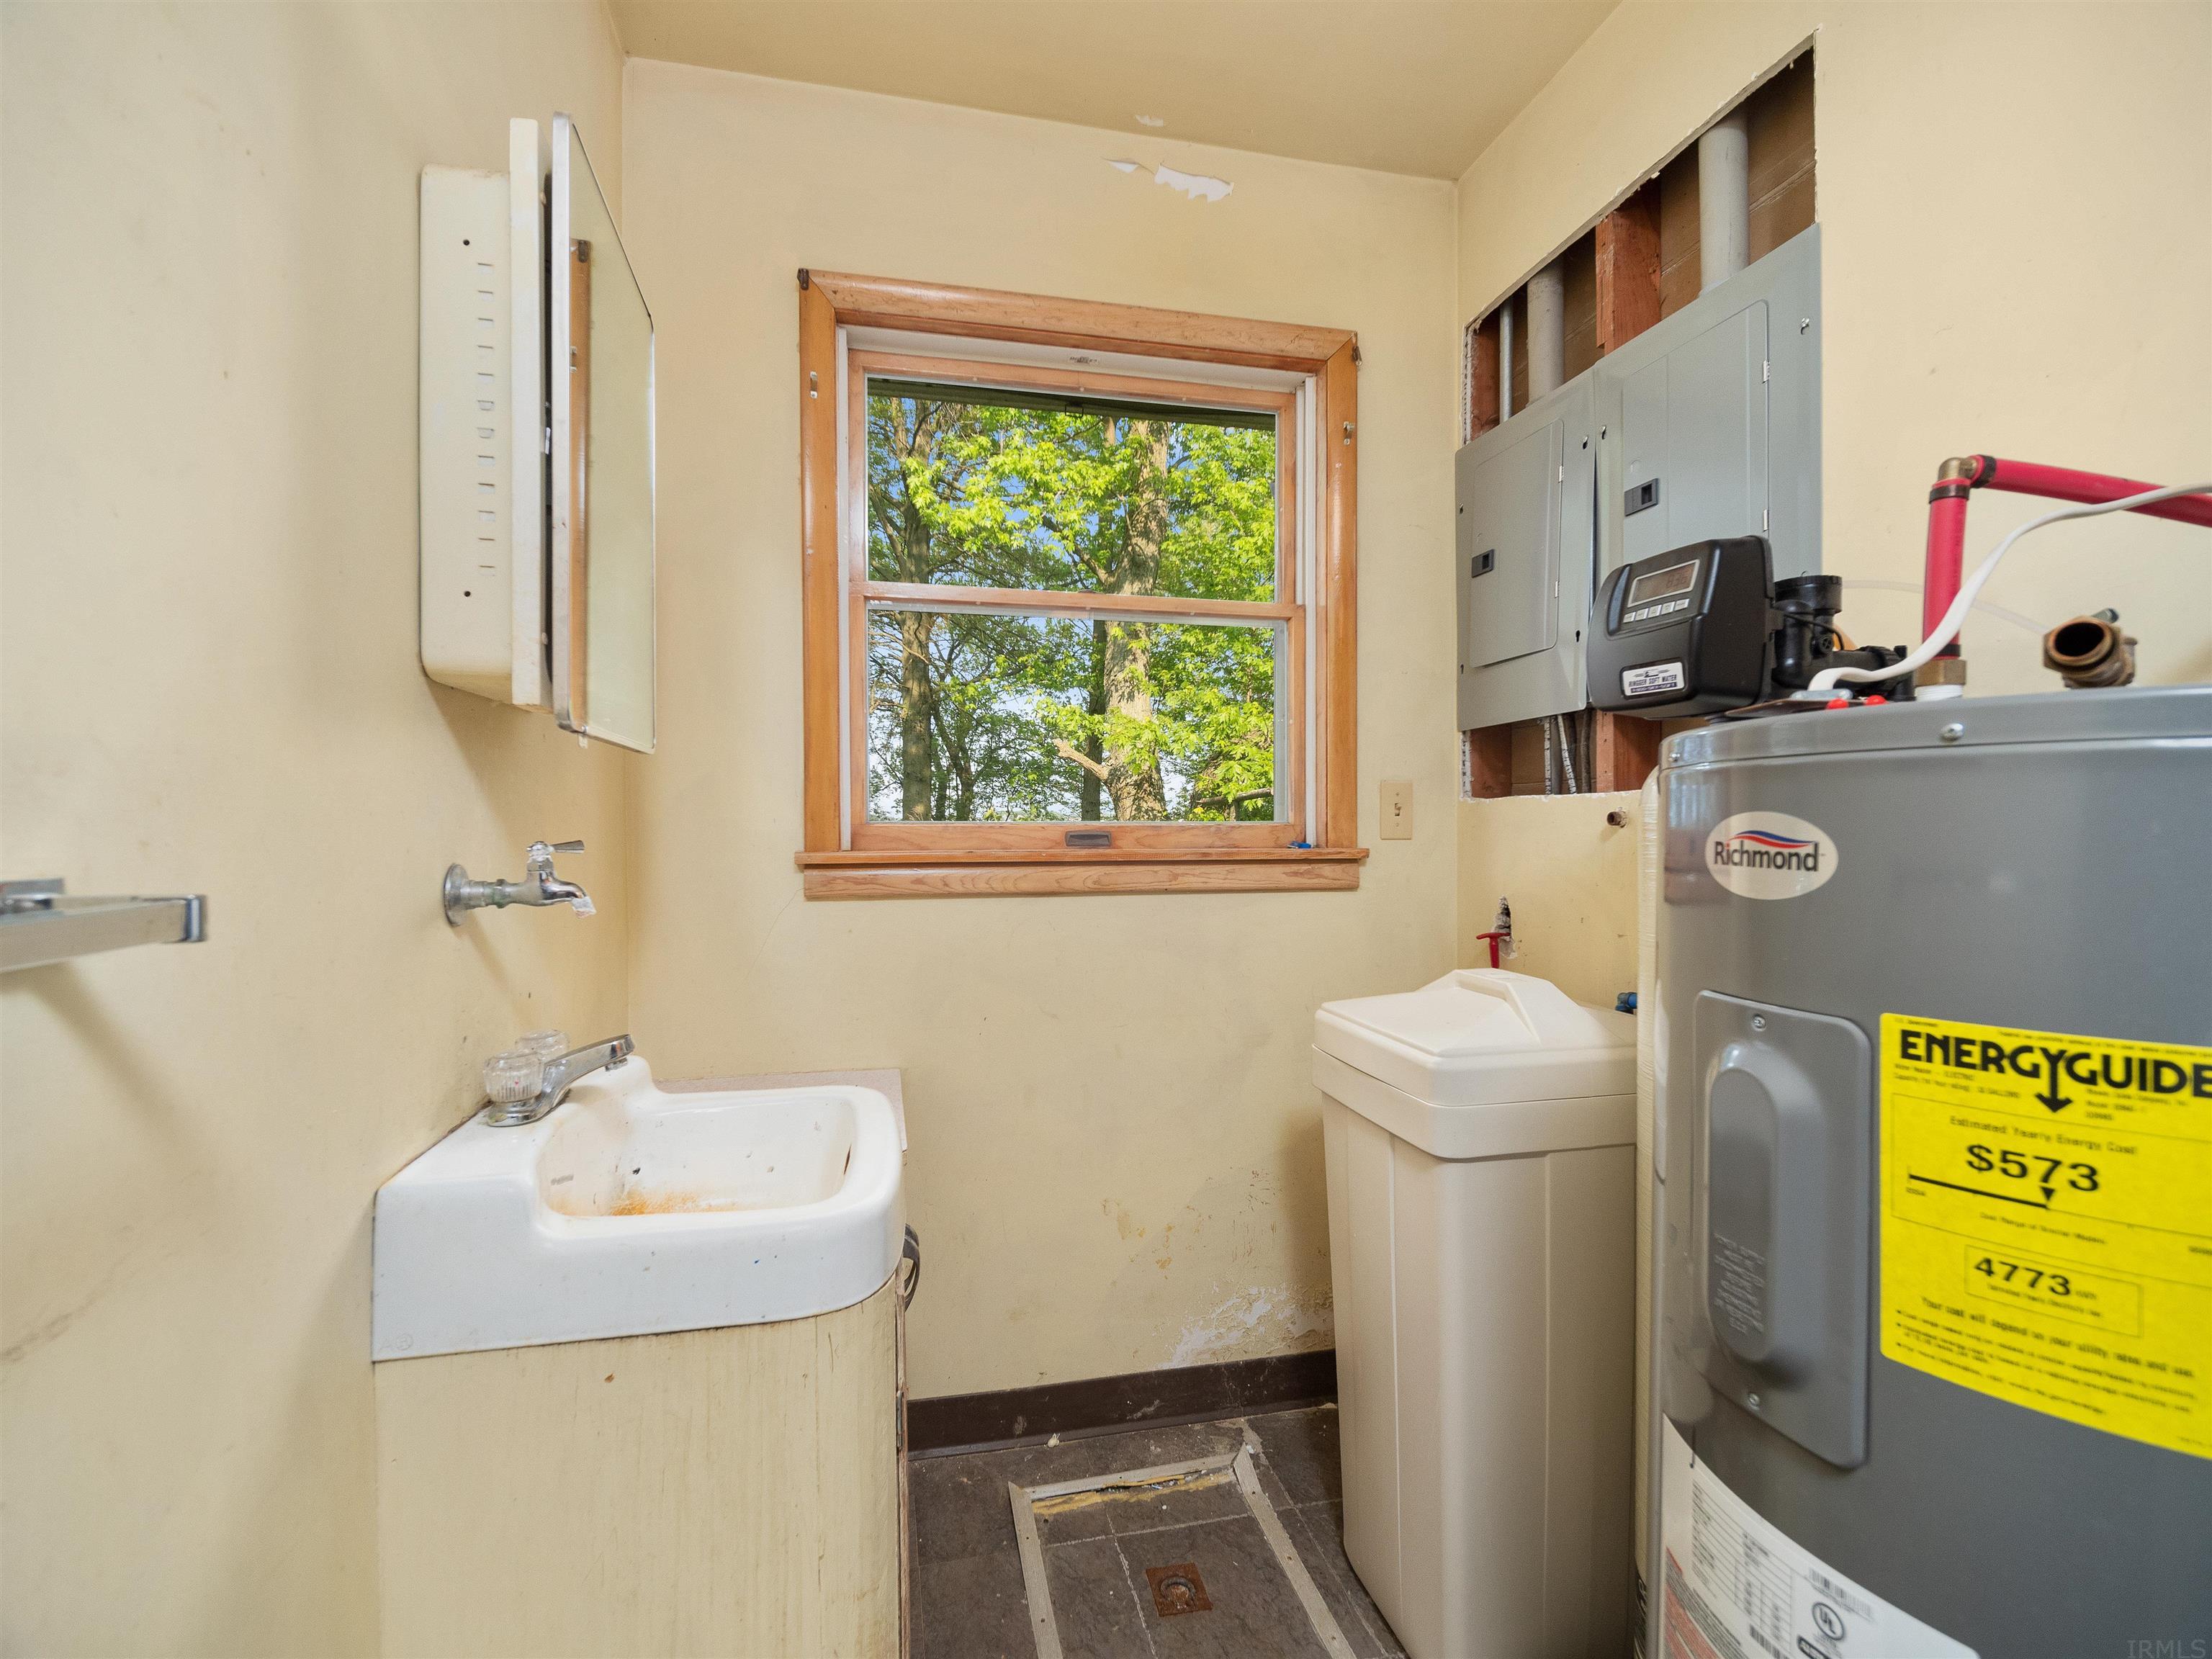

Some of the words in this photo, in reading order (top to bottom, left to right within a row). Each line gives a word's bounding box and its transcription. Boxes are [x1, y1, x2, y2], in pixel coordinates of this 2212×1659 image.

[1714, 840, 1820, 872] Richmond
[1900, 1028, 2212, 1100] ENERGYGUIDE
[1950, 1115, 2007, 1134] Estimated
[2056, 1133, 2101, 1151] Energy
[2107, 1141, 2136, 1154] Cost
[1966, 1143, 2100, 1192] $573
[1974, 1256, 2072, 1296] 4773
